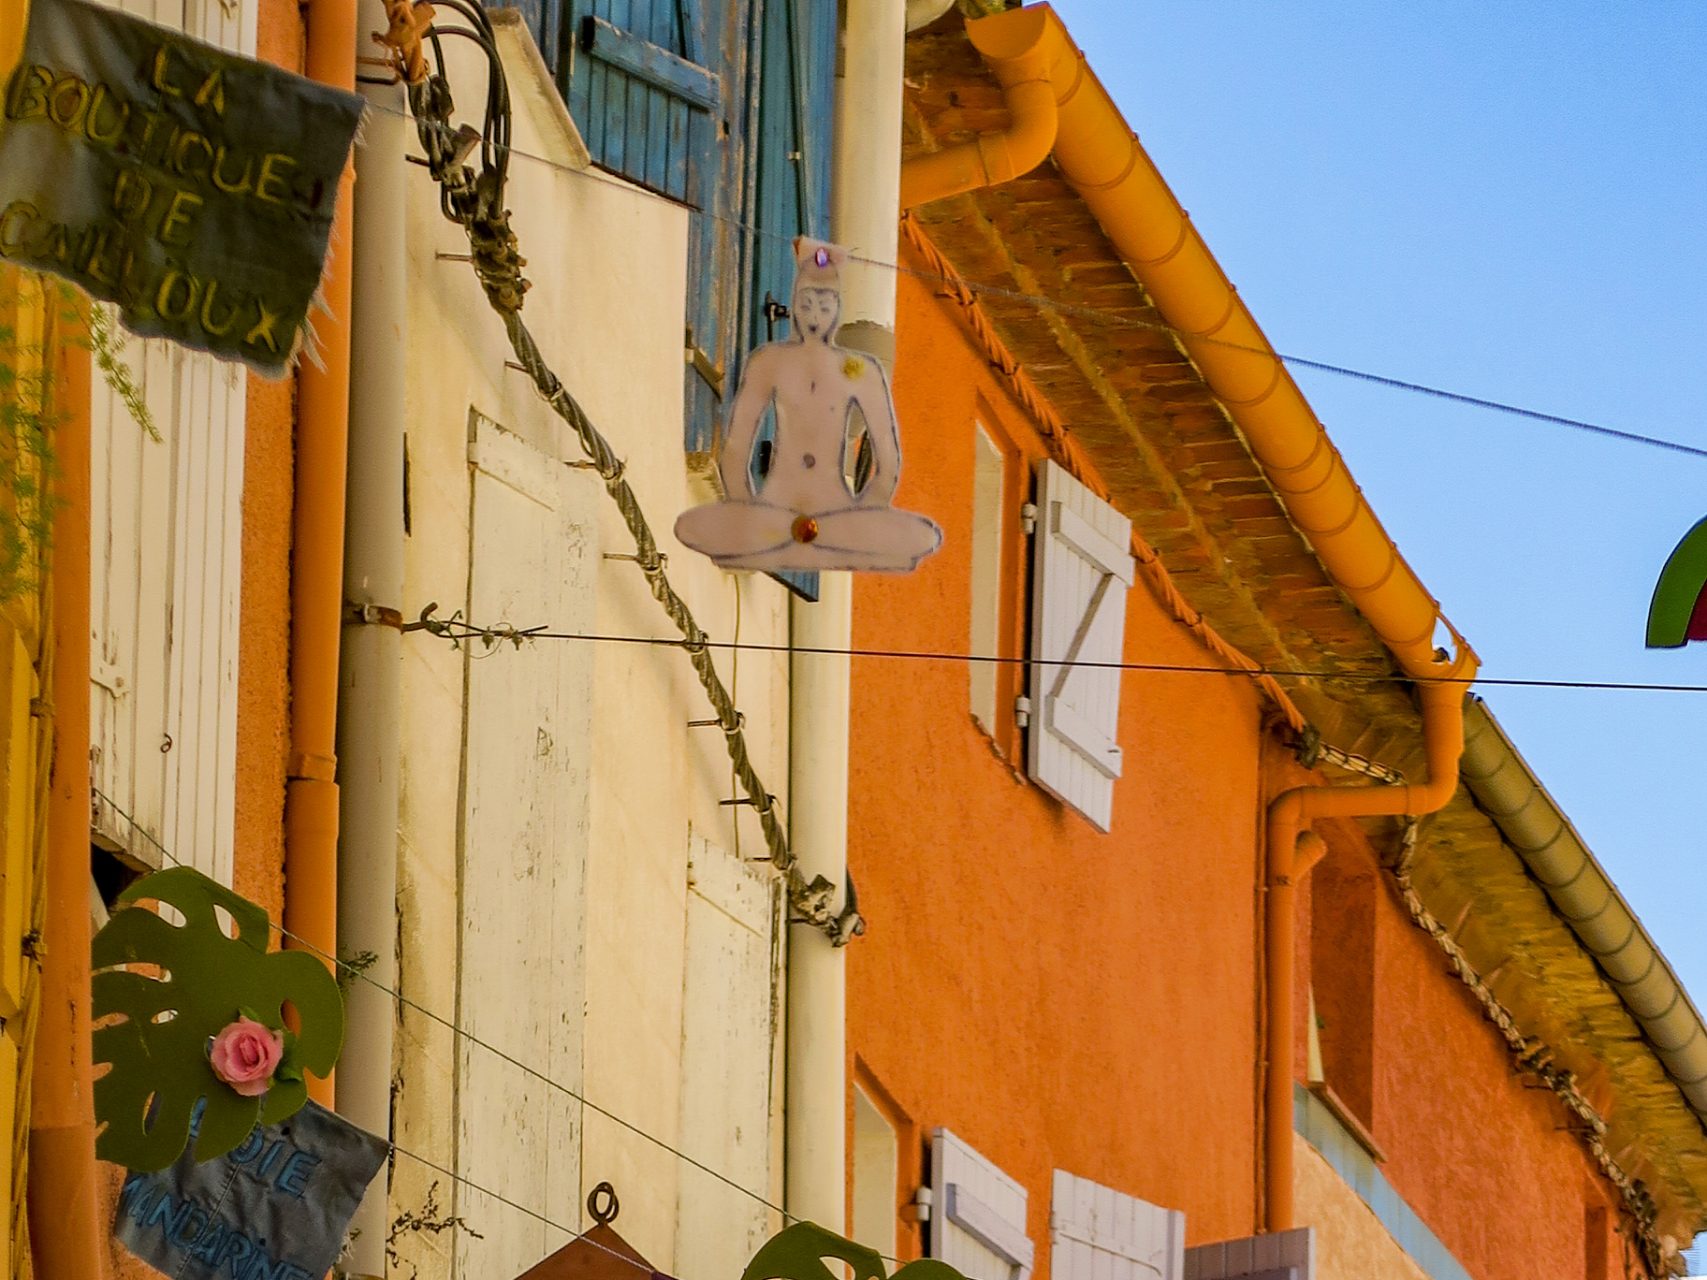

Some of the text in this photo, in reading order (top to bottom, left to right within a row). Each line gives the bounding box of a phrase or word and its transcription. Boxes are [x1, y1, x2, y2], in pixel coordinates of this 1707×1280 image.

[153, 44, 225, 118] LA
[5, 63, 299, 205] BOUTIQUE
[113, 167, 205, 248] DE
